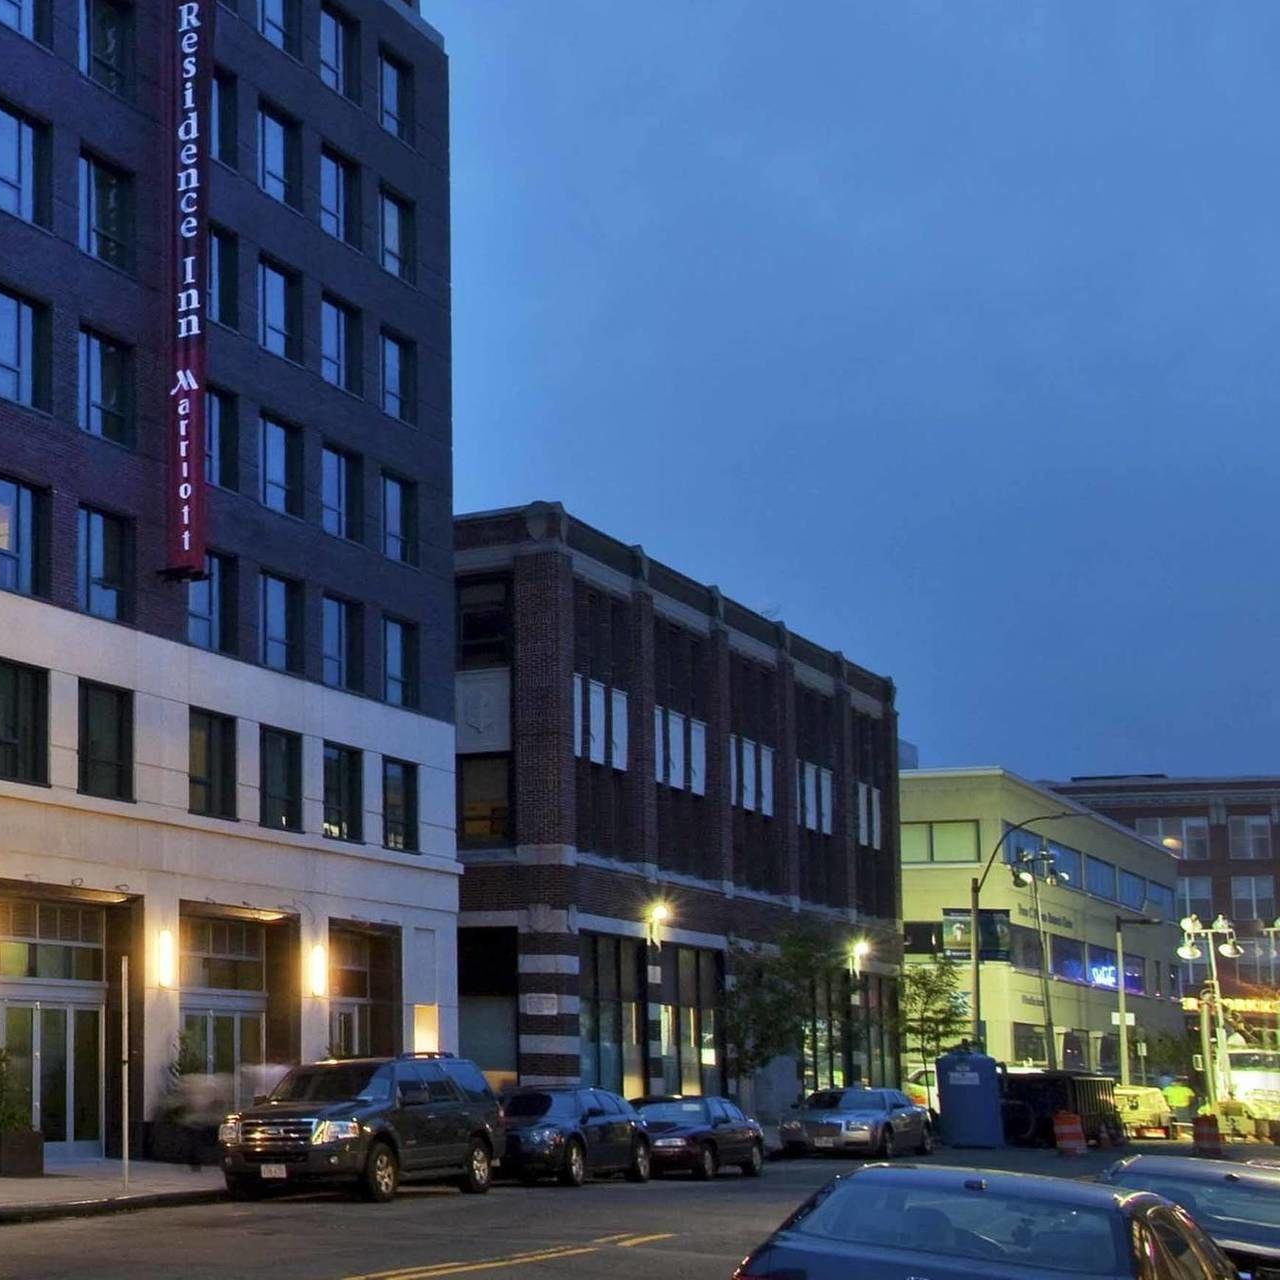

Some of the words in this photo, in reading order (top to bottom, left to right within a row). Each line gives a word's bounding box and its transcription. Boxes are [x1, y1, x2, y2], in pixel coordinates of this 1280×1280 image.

[177, 2, 201, 238] Residence
[178, 257, 200, 338] Inn
[170, 369, 199, 551] Marriott
